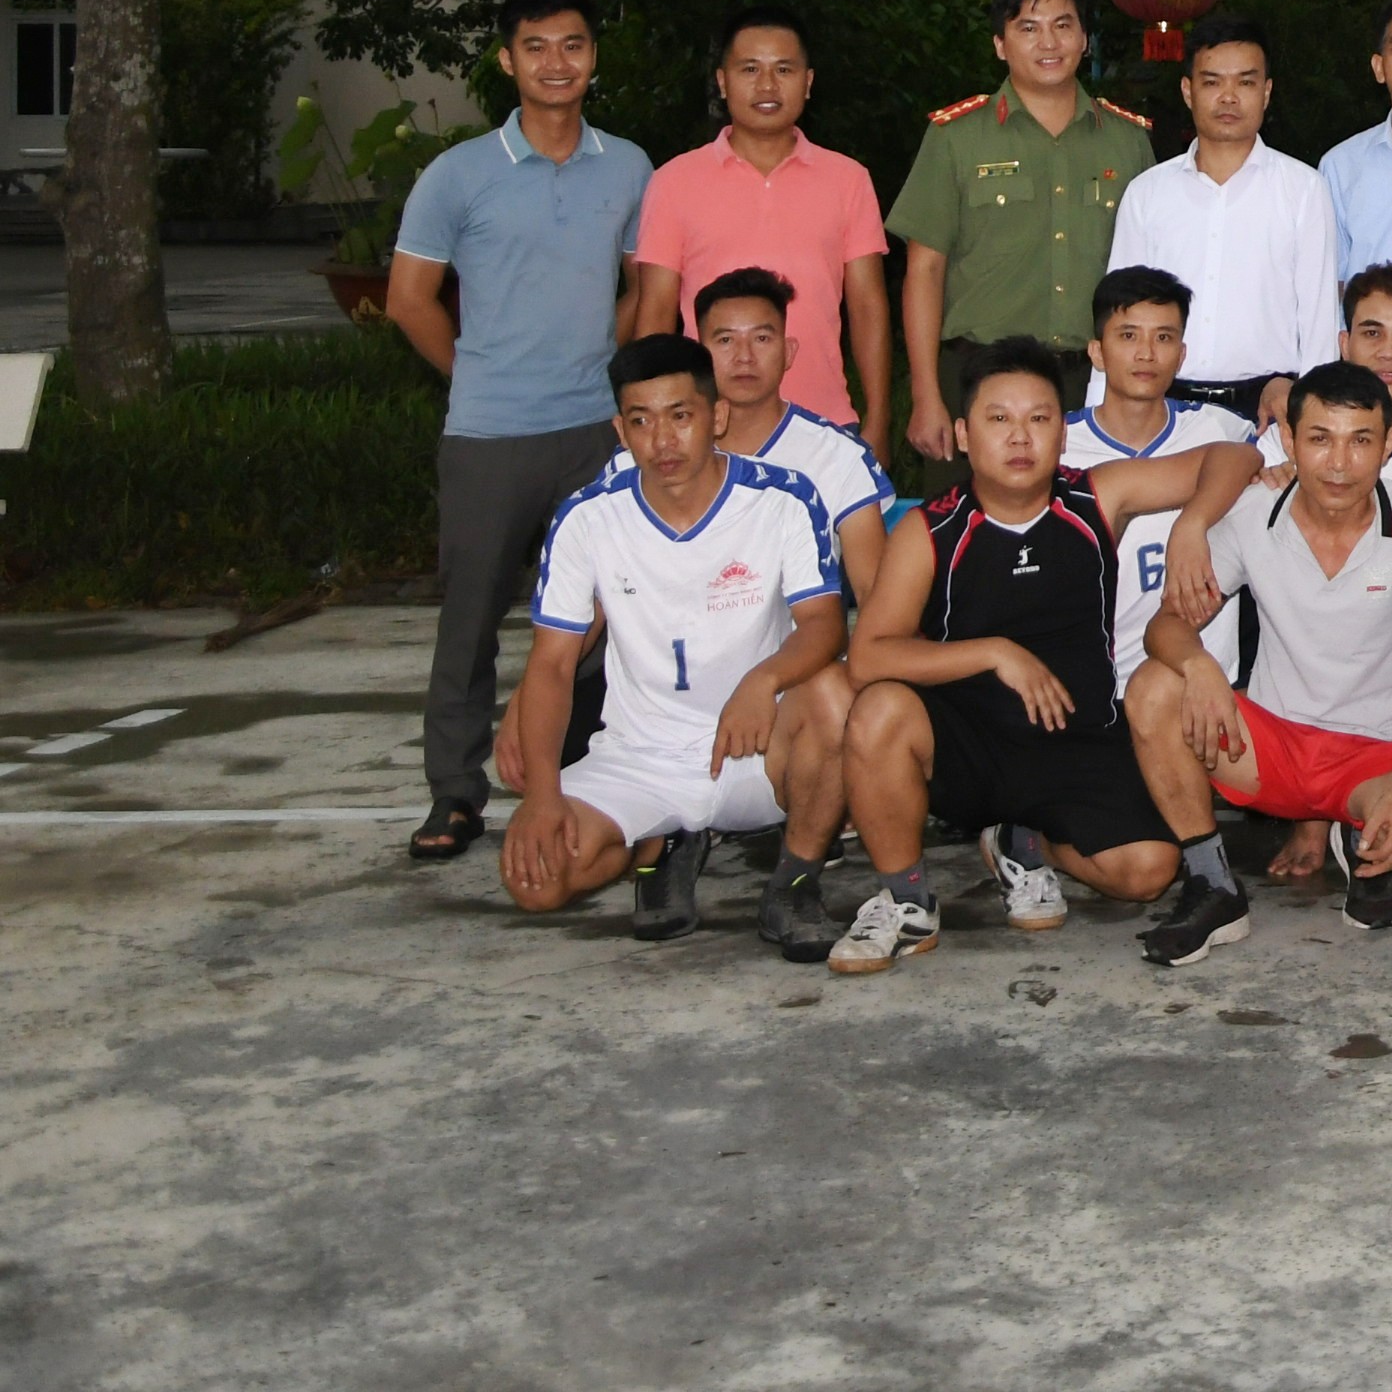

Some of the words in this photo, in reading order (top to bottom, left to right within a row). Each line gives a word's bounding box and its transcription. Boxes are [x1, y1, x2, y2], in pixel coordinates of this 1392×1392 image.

[1137, 542, 1164, 592] 6
[707, 598, 739, 612] HOÀN
[672, 639, 690, 690] 1
